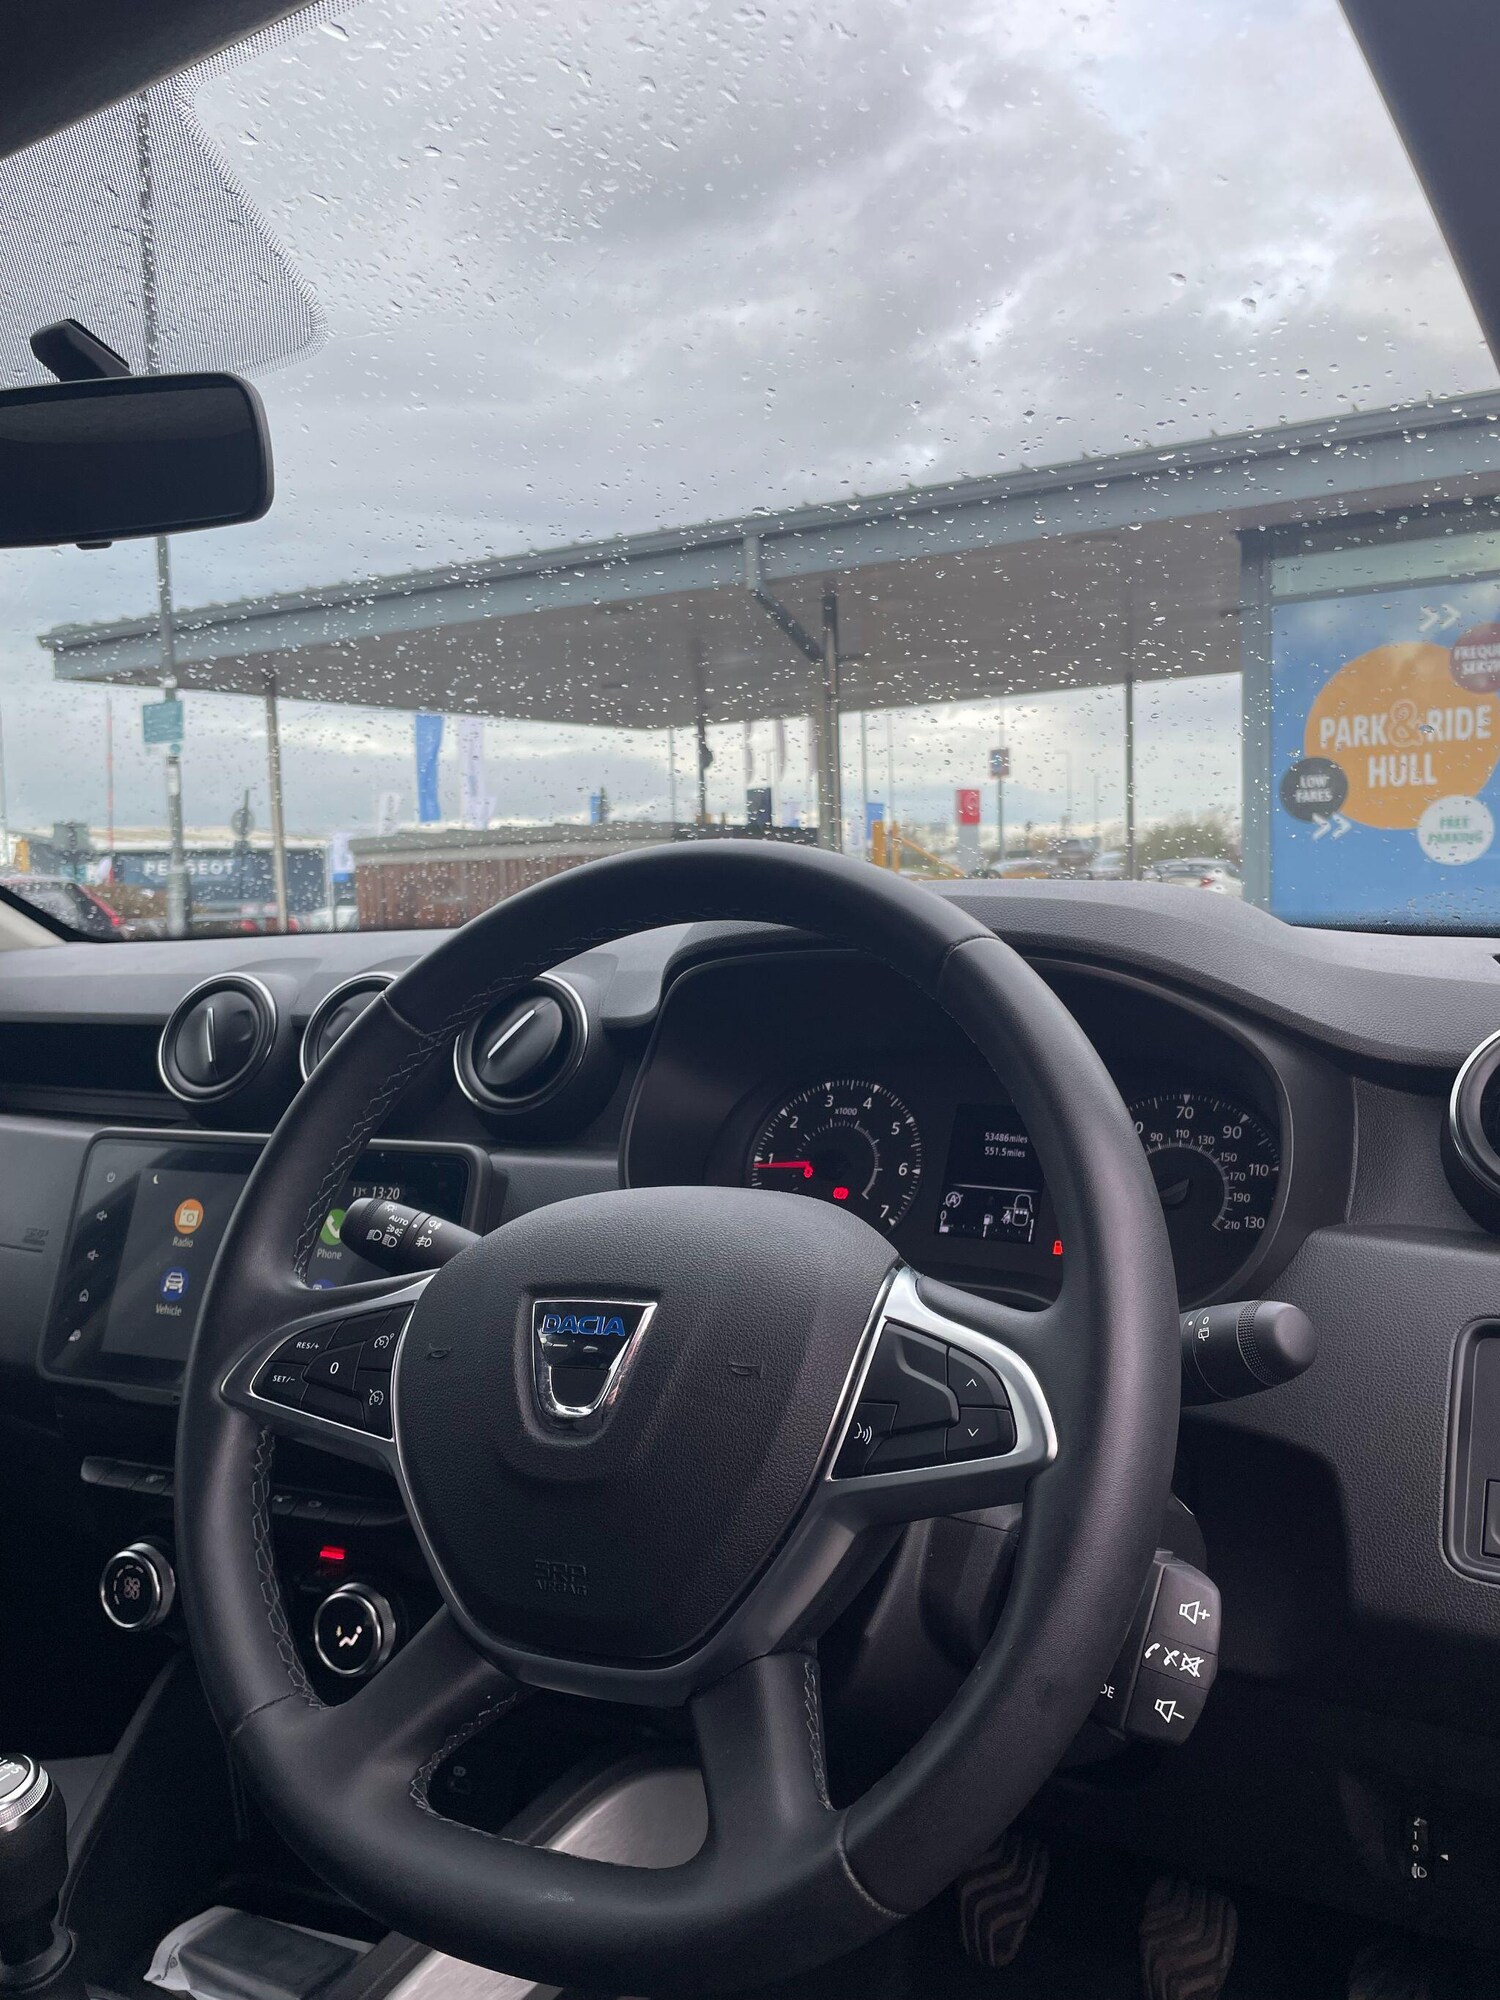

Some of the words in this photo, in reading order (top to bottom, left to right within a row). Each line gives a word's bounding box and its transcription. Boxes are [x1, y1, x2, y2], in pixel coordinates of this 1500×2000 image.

[1319, 713, 1389, 749] PARK
[1388, 698, 1424, 748] &
[1426, 704, 1492, 742] RIDE
[1368, 752, 1437, 788] HULL
[1299, 773, 1328, 788] LOW
[1296, 788, 1333, 803] FARES
[1440, 815, 1471, 830] FREE
[1427, 831, 1483, 845] PARKING
[143, 859, 235, 876] PEGEOT
[824, 1094, 834, 1108] 3
[862, 1096, 873, 1110] 4
[834, 1107, 858, 1116] x1000
[1176, 1105, 1194, 1120] 70
[789, 1115, 799, 1129] 2
[890, 1121, 901, 1135] 5
[1150, 1132, 1163, 1142] 90
[1175, 1128, 1190, 1139] 110
[1222, 1125, 1242, 1140] 90
[1198, 1134, 1215, 1146] 130
[768, 1152, 774, 1165] 1
[1220, 1152, 1238, 1163] 150
[898, 1162, 908, 1176] 6
[1248, 1162, 1269, 1177] 110
[1229, 1171, 1246, 1182] 170
[372, 1185, 400, 1200] 13:20
[1232, 1192, 1250, 1203] 190
[880, 1204, 890, 1219] 7
[388, 1214, 409, 1226] AUTO
[1224, 1220, 1240, 1231] 210
[1243, 1216, 1265, 1230] 130
[172, 1236, 194, 1248] Radio
[316, 1248, 343, 1260] Phone
[155, 1303, 182, 1317] Vehicle
[541, 1314, 626, 1337] DACIA
[1202, 1316, 1210, 1325] 0
[296, 1341, 320, 1350] RES/+
[329, 1361, 340, 1375] 0
[272, 1374, 296, 1384] SET/-
[1412, 1844, 1419, 1852] 0
